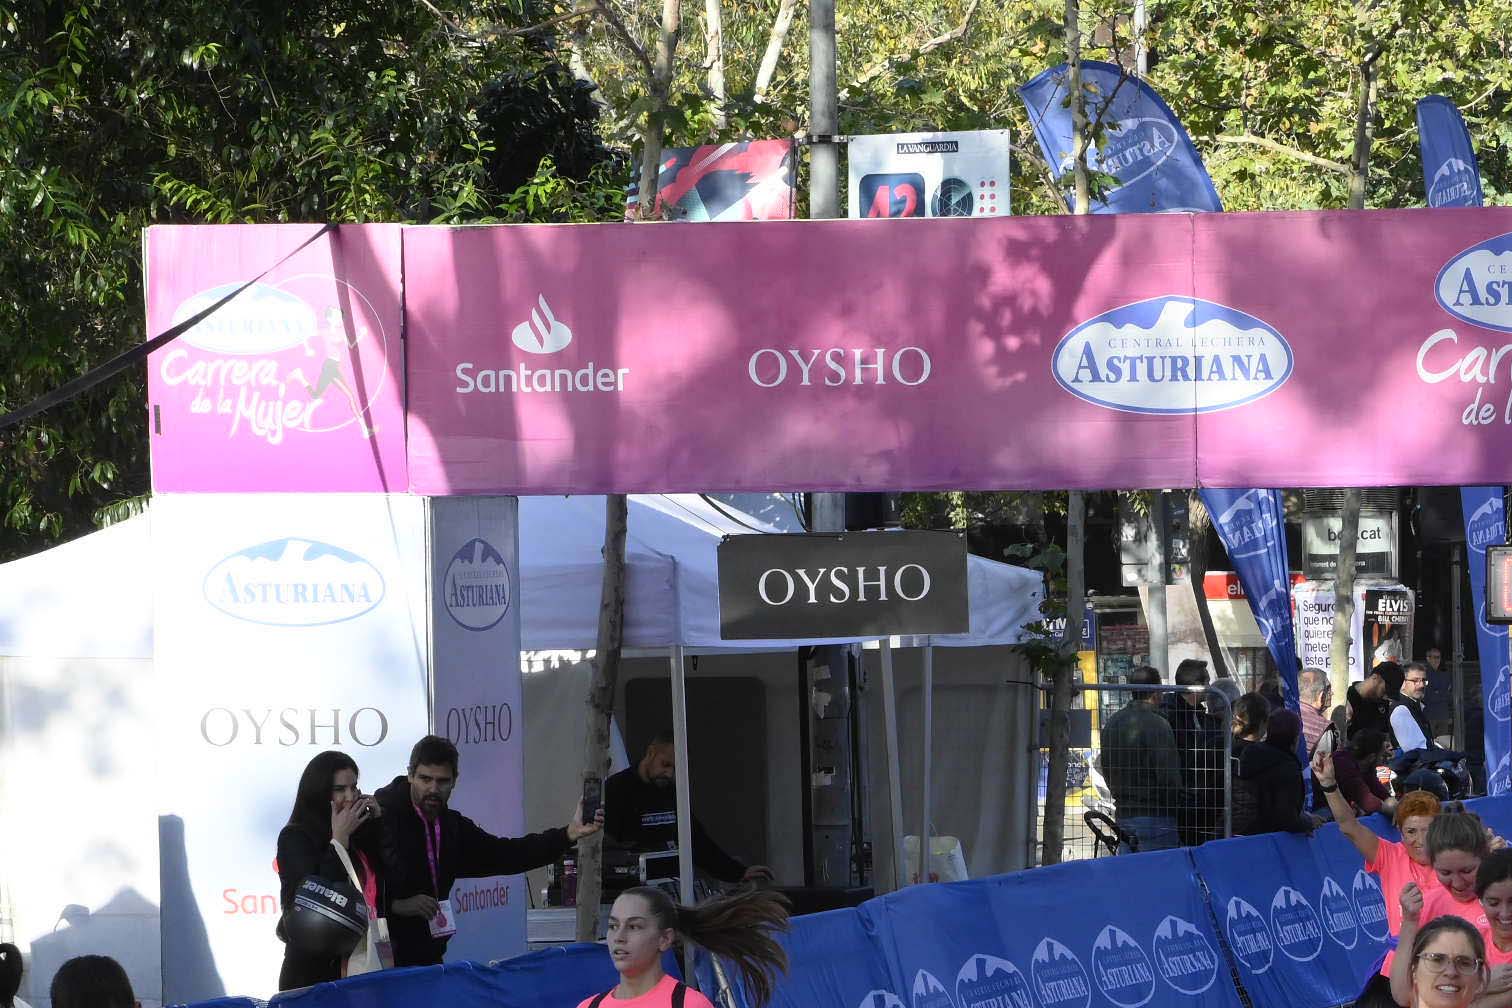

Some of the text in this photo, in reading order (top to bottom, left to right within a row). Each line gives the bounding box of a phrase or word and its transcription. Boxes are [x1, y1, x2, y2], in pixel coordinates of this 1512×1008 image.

[908, 141, 957, 153] VANGUARDIA
[1109, 336, 1266, 348] CENTRAL LECHERA
[160, 348, 279, 387] Carrera
[456, 362, 630, 393] Santander
[748, 346, 932, 387] OYSHO
[1071, 341, 1273, 384] ASTURIANA
[191, 393, 323, 445] de la Mujer
[1462, 388, 1495, 426] de
[1328, 526, 1382, 542] b.cat
[218, 573, 372, 605] ASTURIANA
[449, 575, 506, 608] ASTURIANA
[758, 562, 931, 606] OYSHO
[1378, 599, 1409, 612] ELVIS
[1303, 616, 1320, 629] que
[1304, 628, 1335, 642] quiere
[1305, 655, 1324, 666] este
[200, 706, 389, 747] OYSHO
[446, 702, 512, 745] OYSHO
[454, 883, 512, 914] Santander
